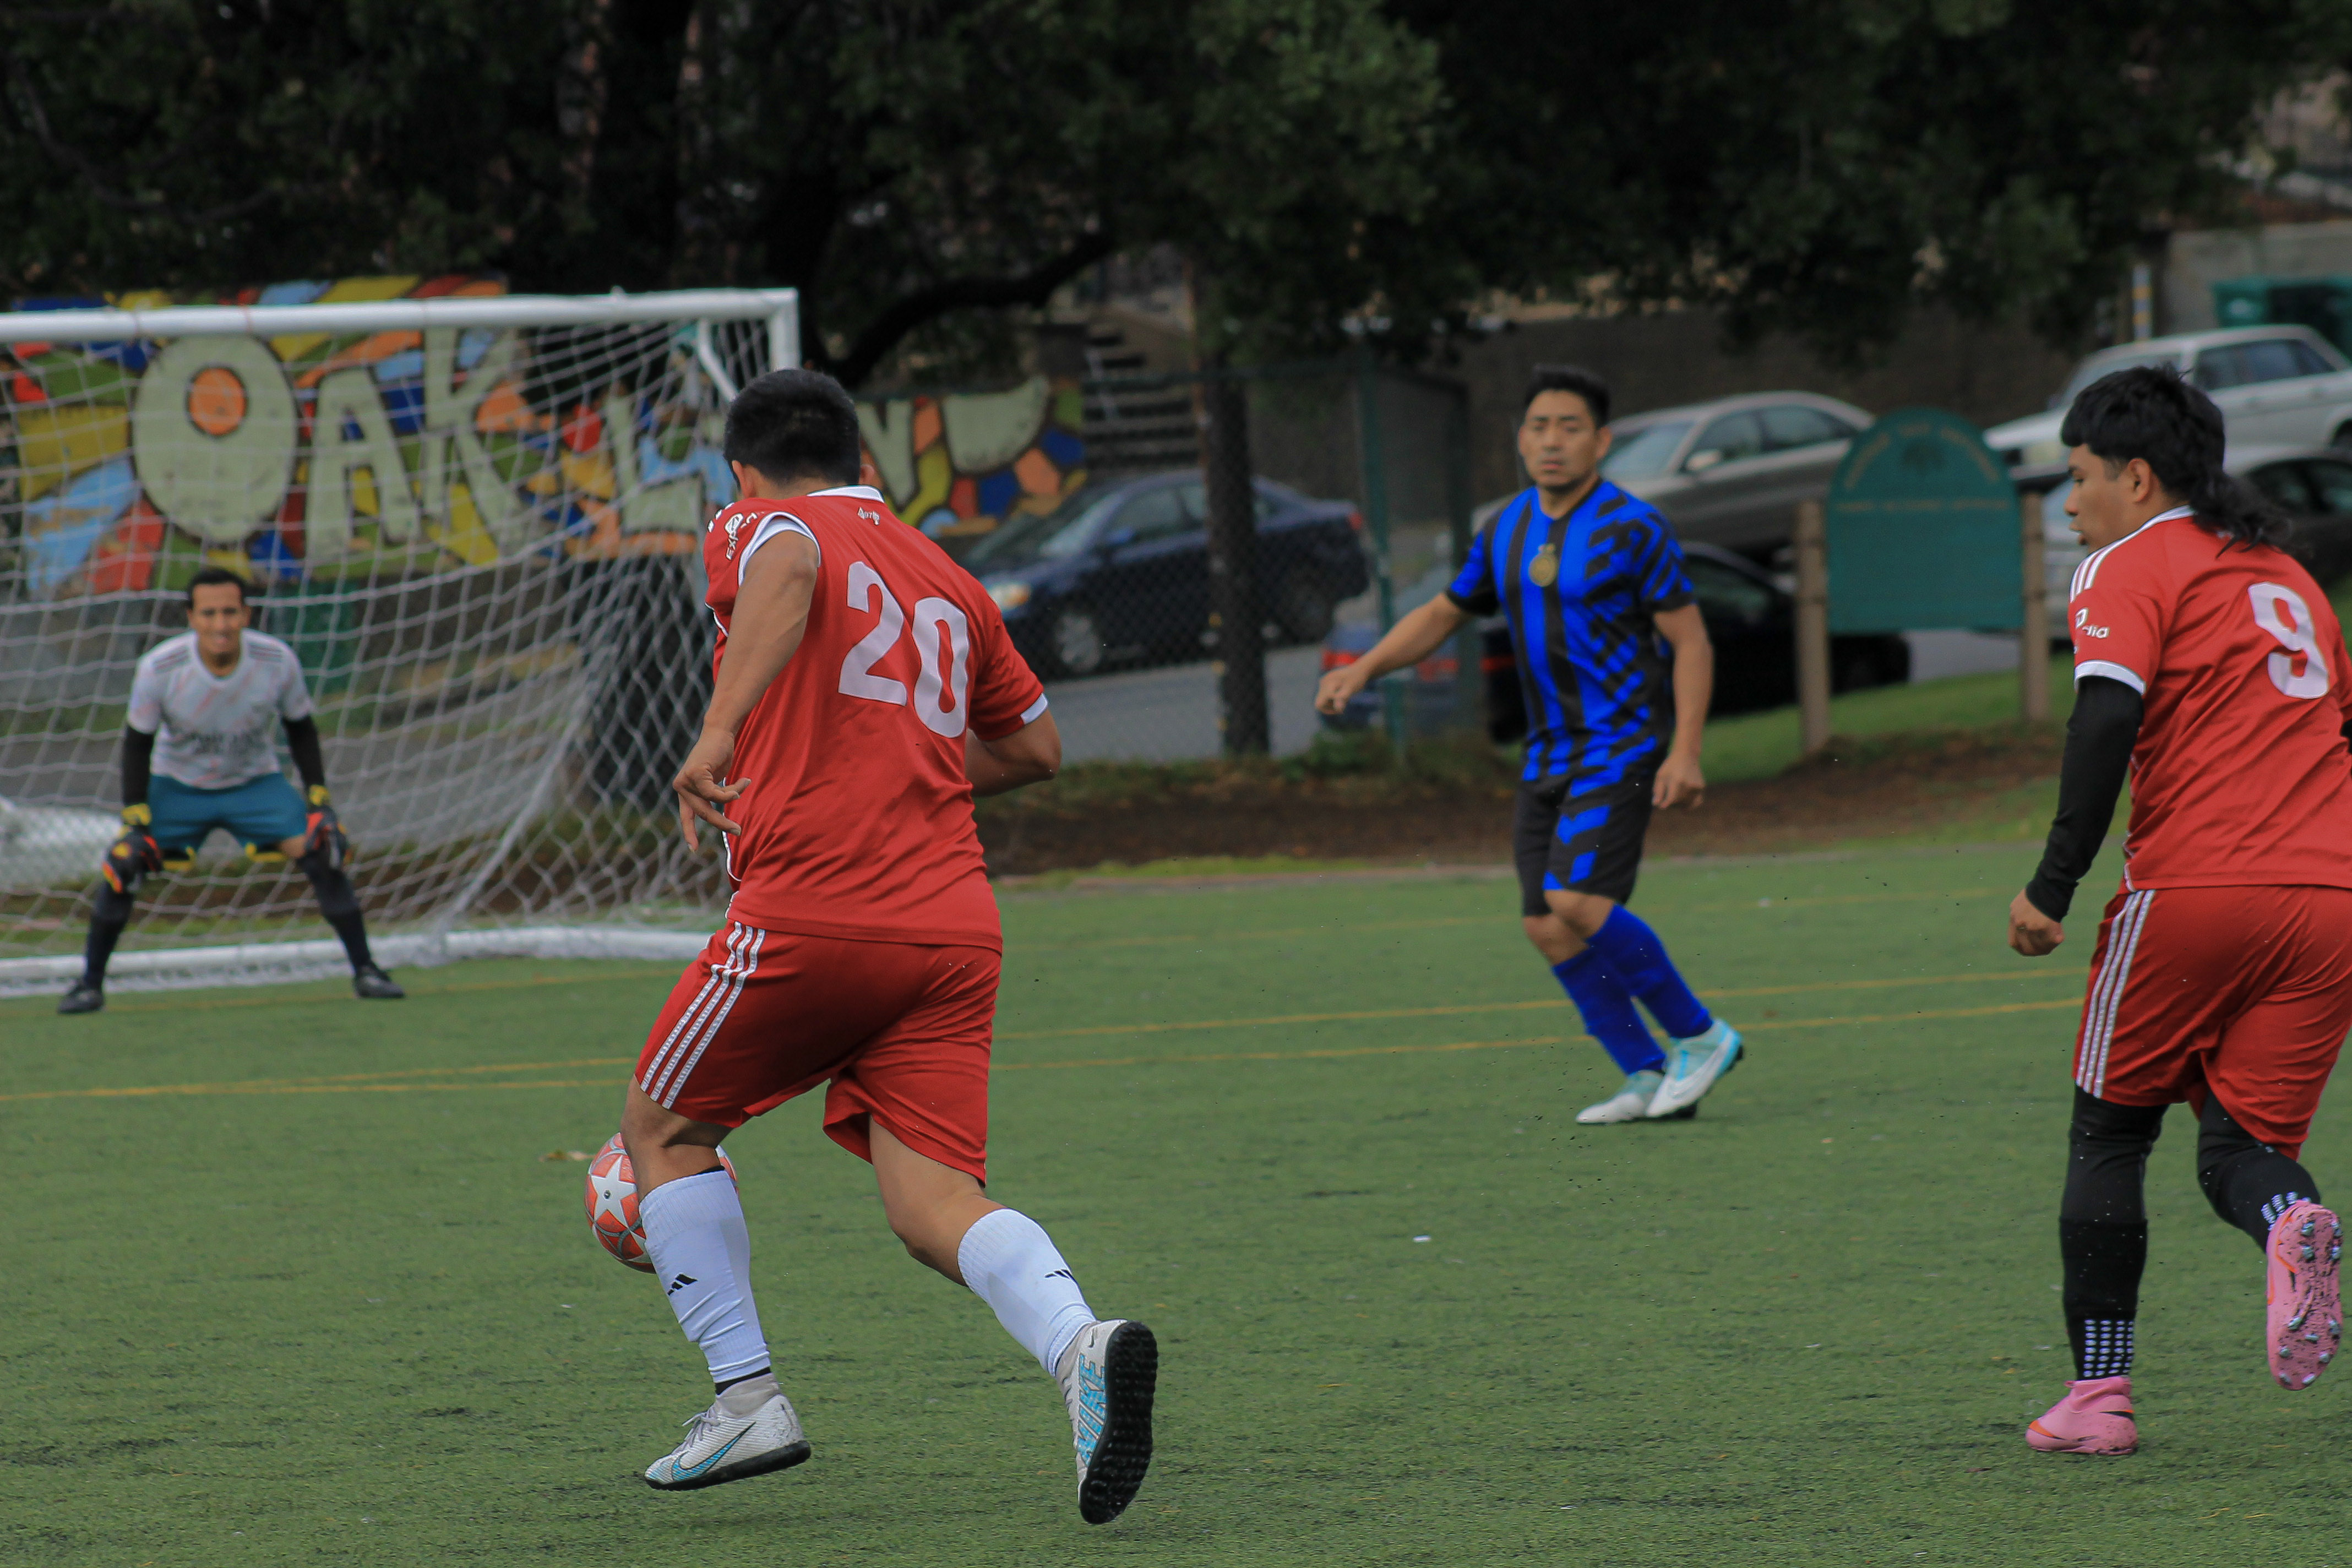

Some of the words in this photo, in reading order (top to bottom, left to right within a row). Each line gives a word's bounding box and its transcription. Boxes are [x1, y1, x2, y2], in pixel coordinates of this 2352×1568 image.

[837, 560, 970, 739] 20
[2248, 581, 2330, 699] 9
[1076, 1353, 1107, 1467] NIKE
